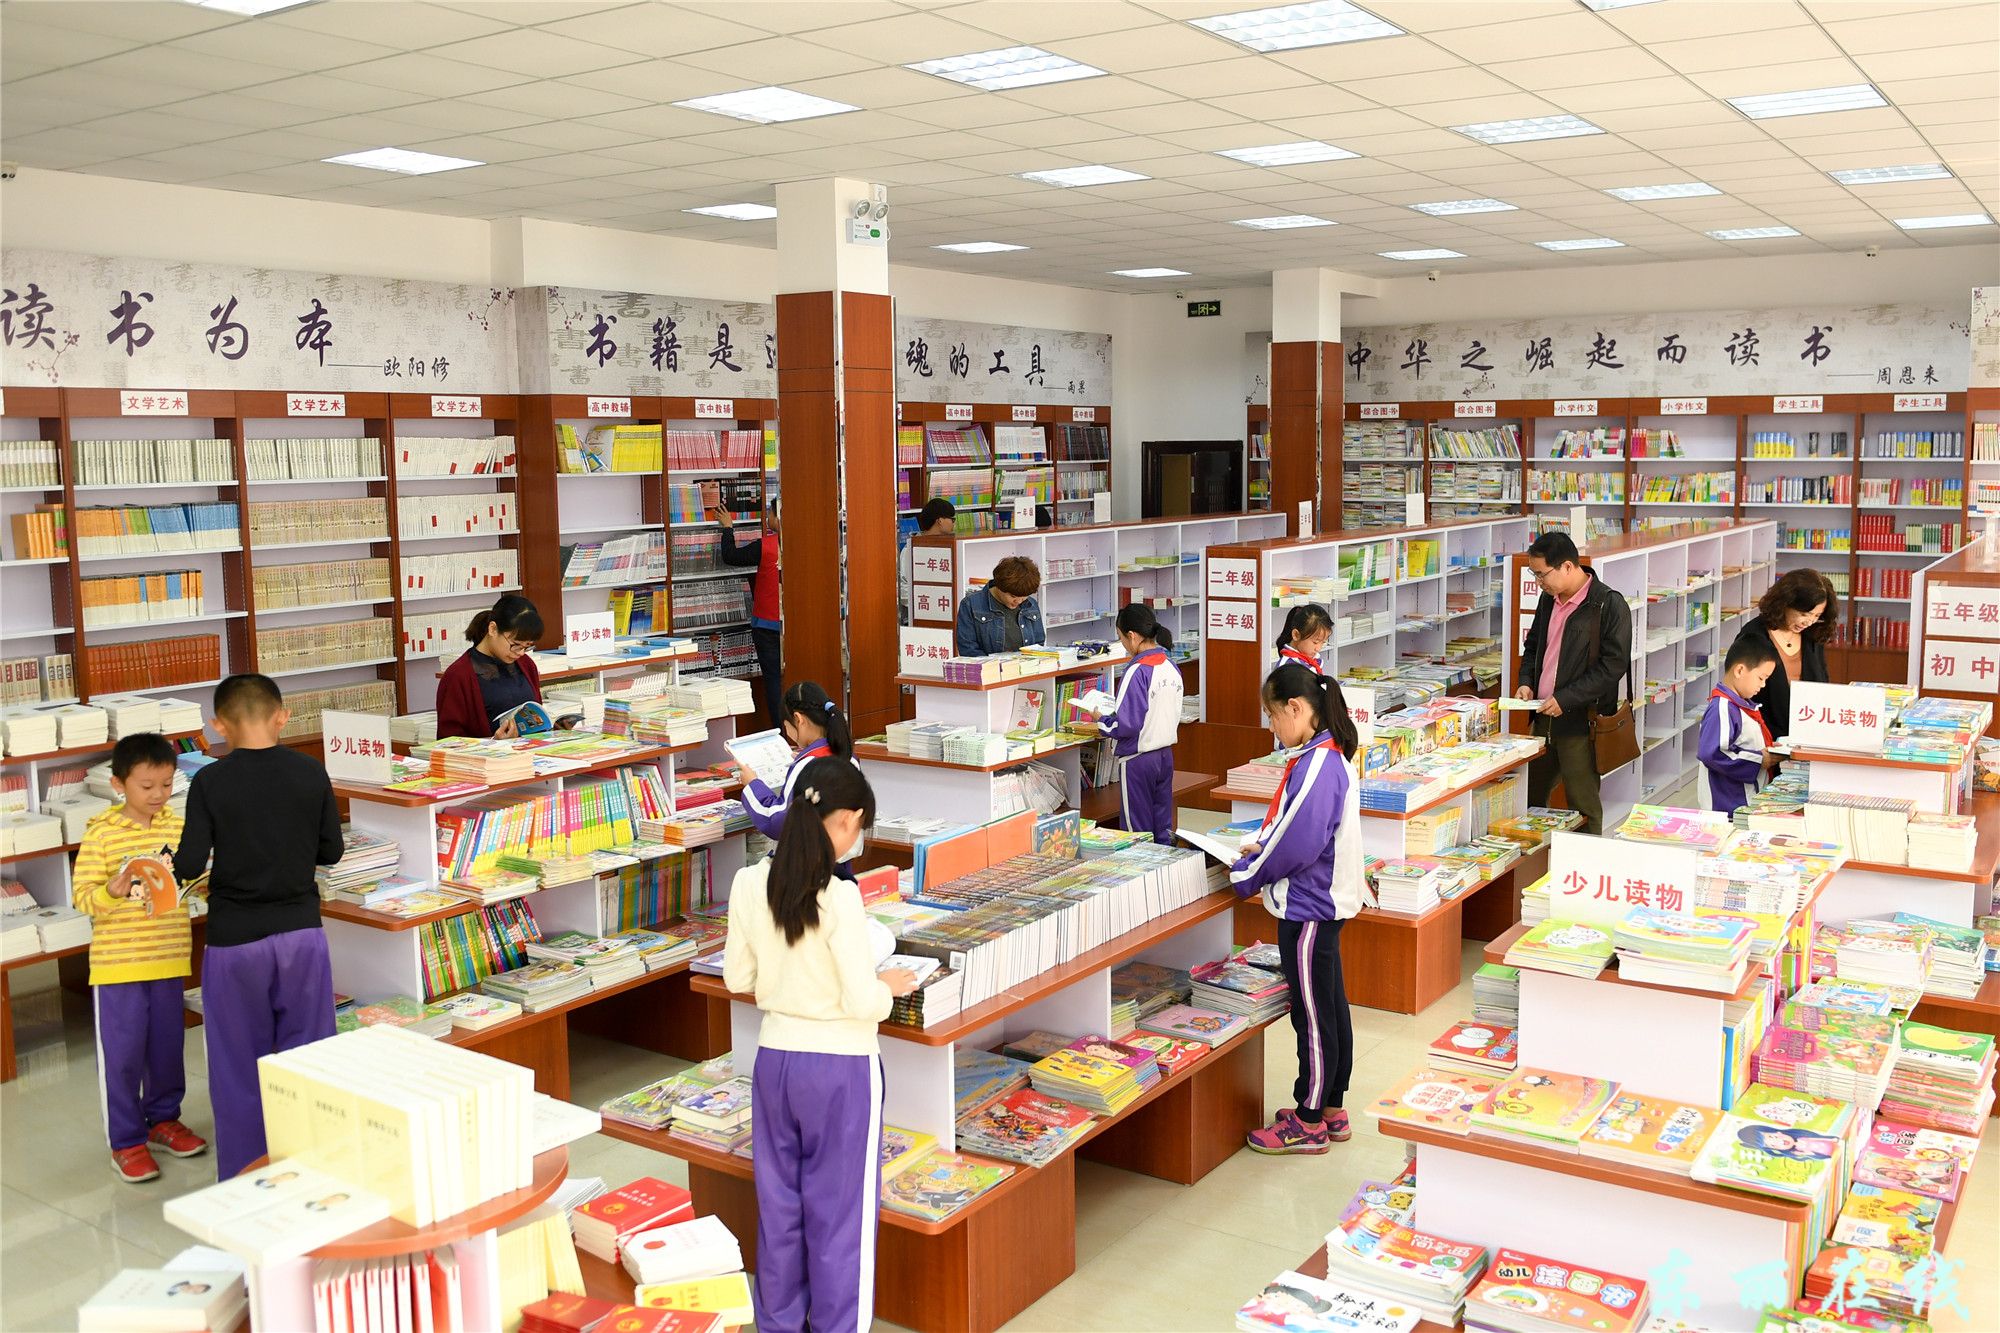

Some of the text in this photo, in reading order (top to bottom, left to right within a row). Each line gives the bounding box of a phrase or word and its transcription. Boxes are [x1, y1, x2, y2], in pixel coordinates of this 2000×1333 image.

[0, 283, 334, 367] 读书为本
[1347, 325, 1833, 381] 中华之崛起而读书
[383, 356, 450, 381] 欧阳修
[906, 337, 1046, 386] 魂的工具
[1876, 364, 1939, 385] 周恩来
[126, 396, 185, 411] 文学艺术
[292, 397, 342, 411] 文学艺术
[437, 399, 479, 412] 文学艺术
[591, 401, 630, 413] 高中教辅
[698, 402, 731, 414] 高中教辅
[1458, 405, 1493, 415] 综合图书
[1557, 404, 1595, 413] 小学作文
[1664, 402, 1703, 412] 小学作文
[1778, 399, 1821, 409] 学生工具
[1899, 397, 1943, 408] 学生工具
[948, 408, 971, 418] 高中教辅
[1014, 408, 1034, 418] 高中教辅
[1363, 407, 1397, 416] 综合图书
[1017, 508, 1034, 516] 一年级
[915, 558, 951, 573] 一年级
[1209, 570, 1255, 587] 二年级
[917, 594, 951, 611] 高中
[1930, 602, 1999, 623] 五年级
[1209, 613, 1255, 630] 三年级
[568, 627, 611, 642] 青少读物
[905, 643, 949, 660] 青少读物
[1931, 654, 1995, 680] 初中
[1798, 705, 1877, 729] 少儿读物
[330, 735, 386, 758] 少儿读物
[1563, 870, 1682, 911] 少儿读物
